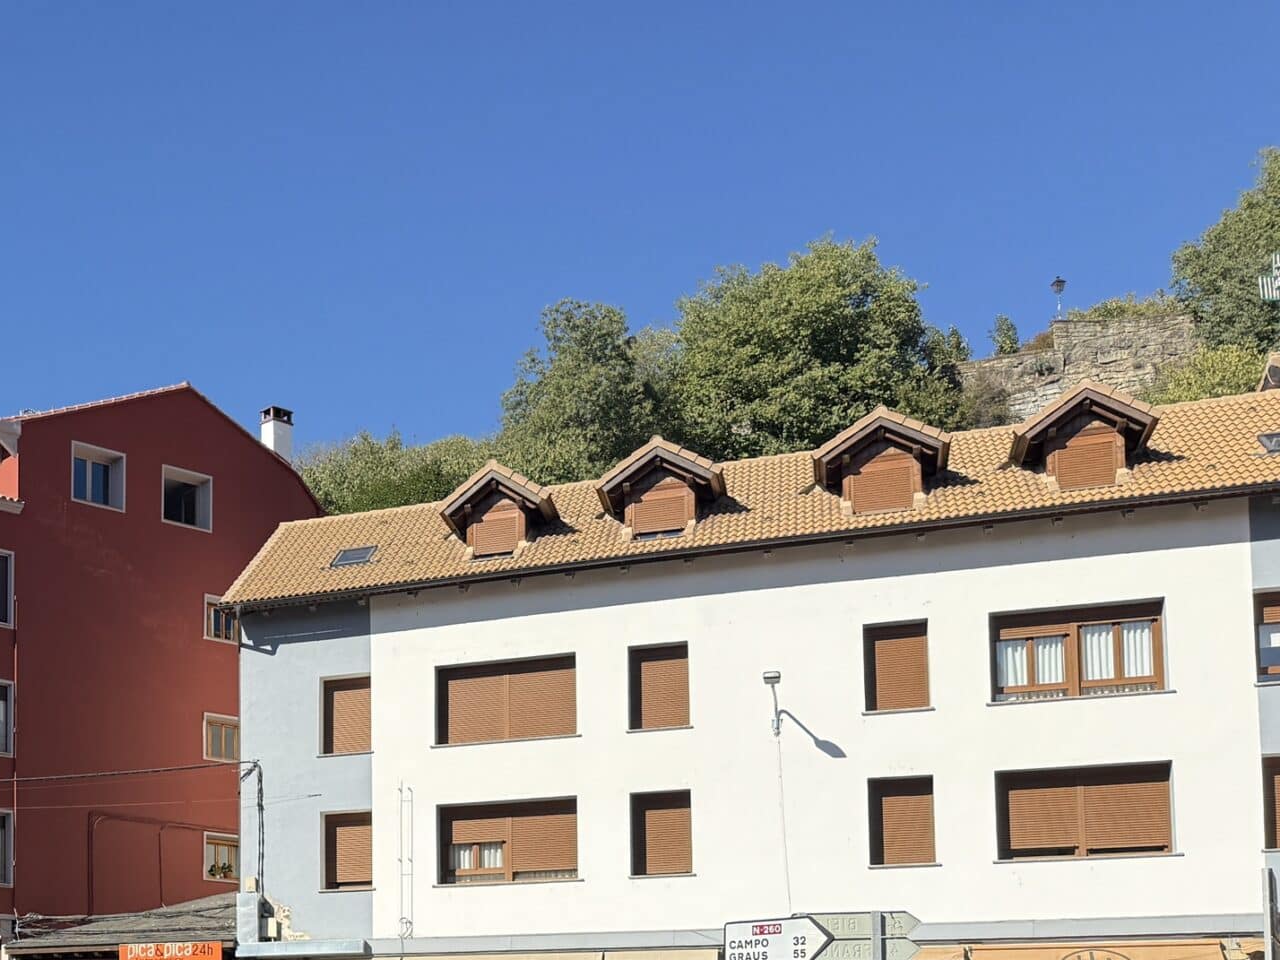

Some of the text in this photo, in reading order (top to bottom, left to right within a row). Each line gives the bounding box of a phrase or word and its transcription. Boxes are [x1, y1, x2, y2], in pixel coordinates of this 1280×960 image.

[752, 924, 781, 935] N-260
[729, 936, 806, 949] CAMPO 32
[793, 949, 806, 958] 55
